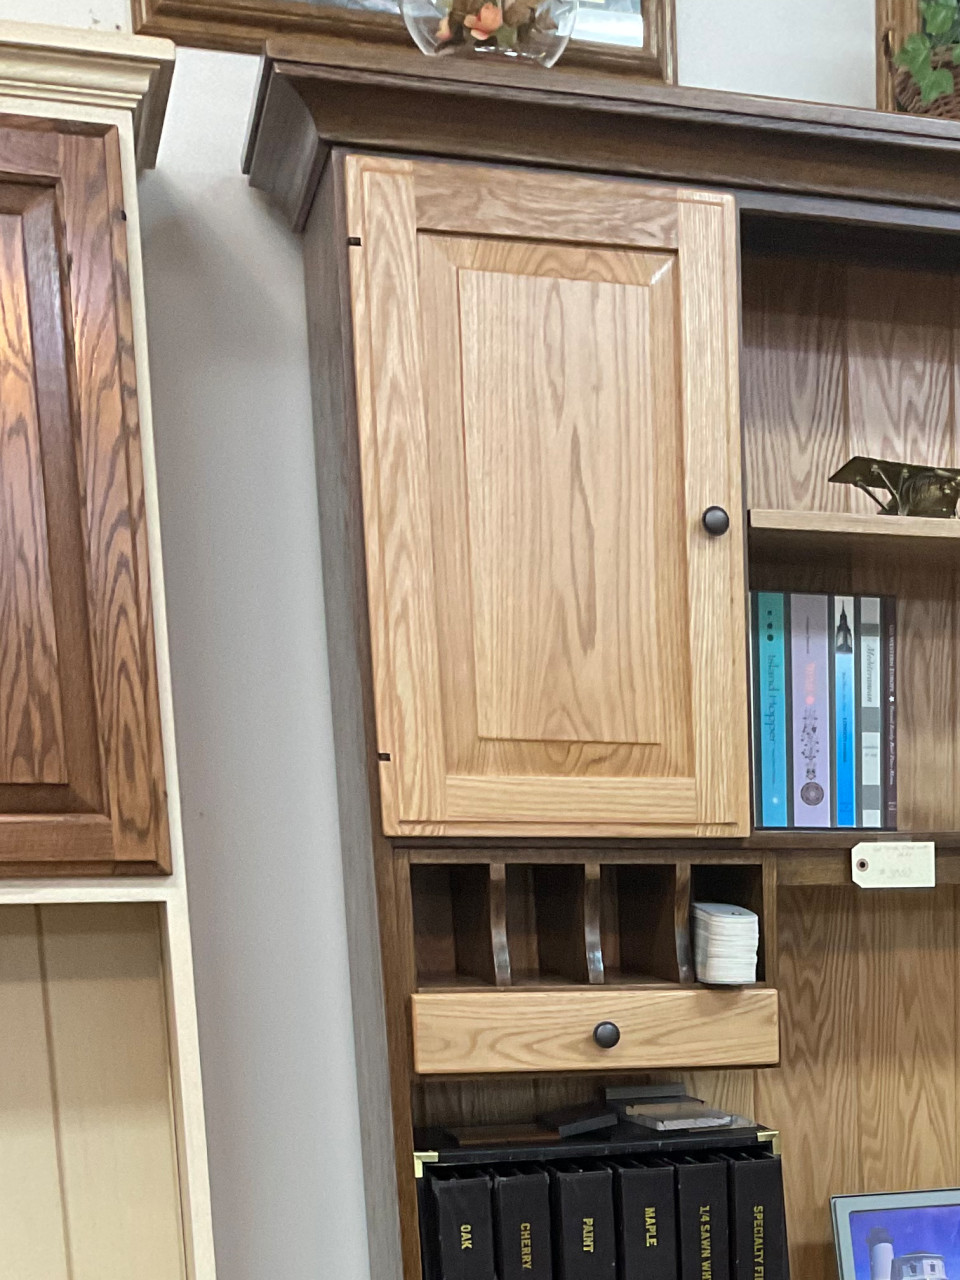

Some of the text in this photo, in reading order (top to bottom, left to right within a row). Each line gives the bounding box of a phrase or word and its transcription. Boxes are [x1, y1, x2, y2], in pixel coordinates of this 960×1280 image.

[768, 654, 779, 692] Island
[764, 695, 777, 741] Hopper
[645, 1207, 657, 1247] MAPLE
[700, 1205, 710, 1222] 1/4
[460, 1224, 472, 1250] OAK
[520, 1222, 532, 1270] CHERRY
[582, 1218, 594, 1253] PAINT
[700, 1224, 711, 1258] SAWN
[753, 1205, 764, 1264] SPECIALTY
